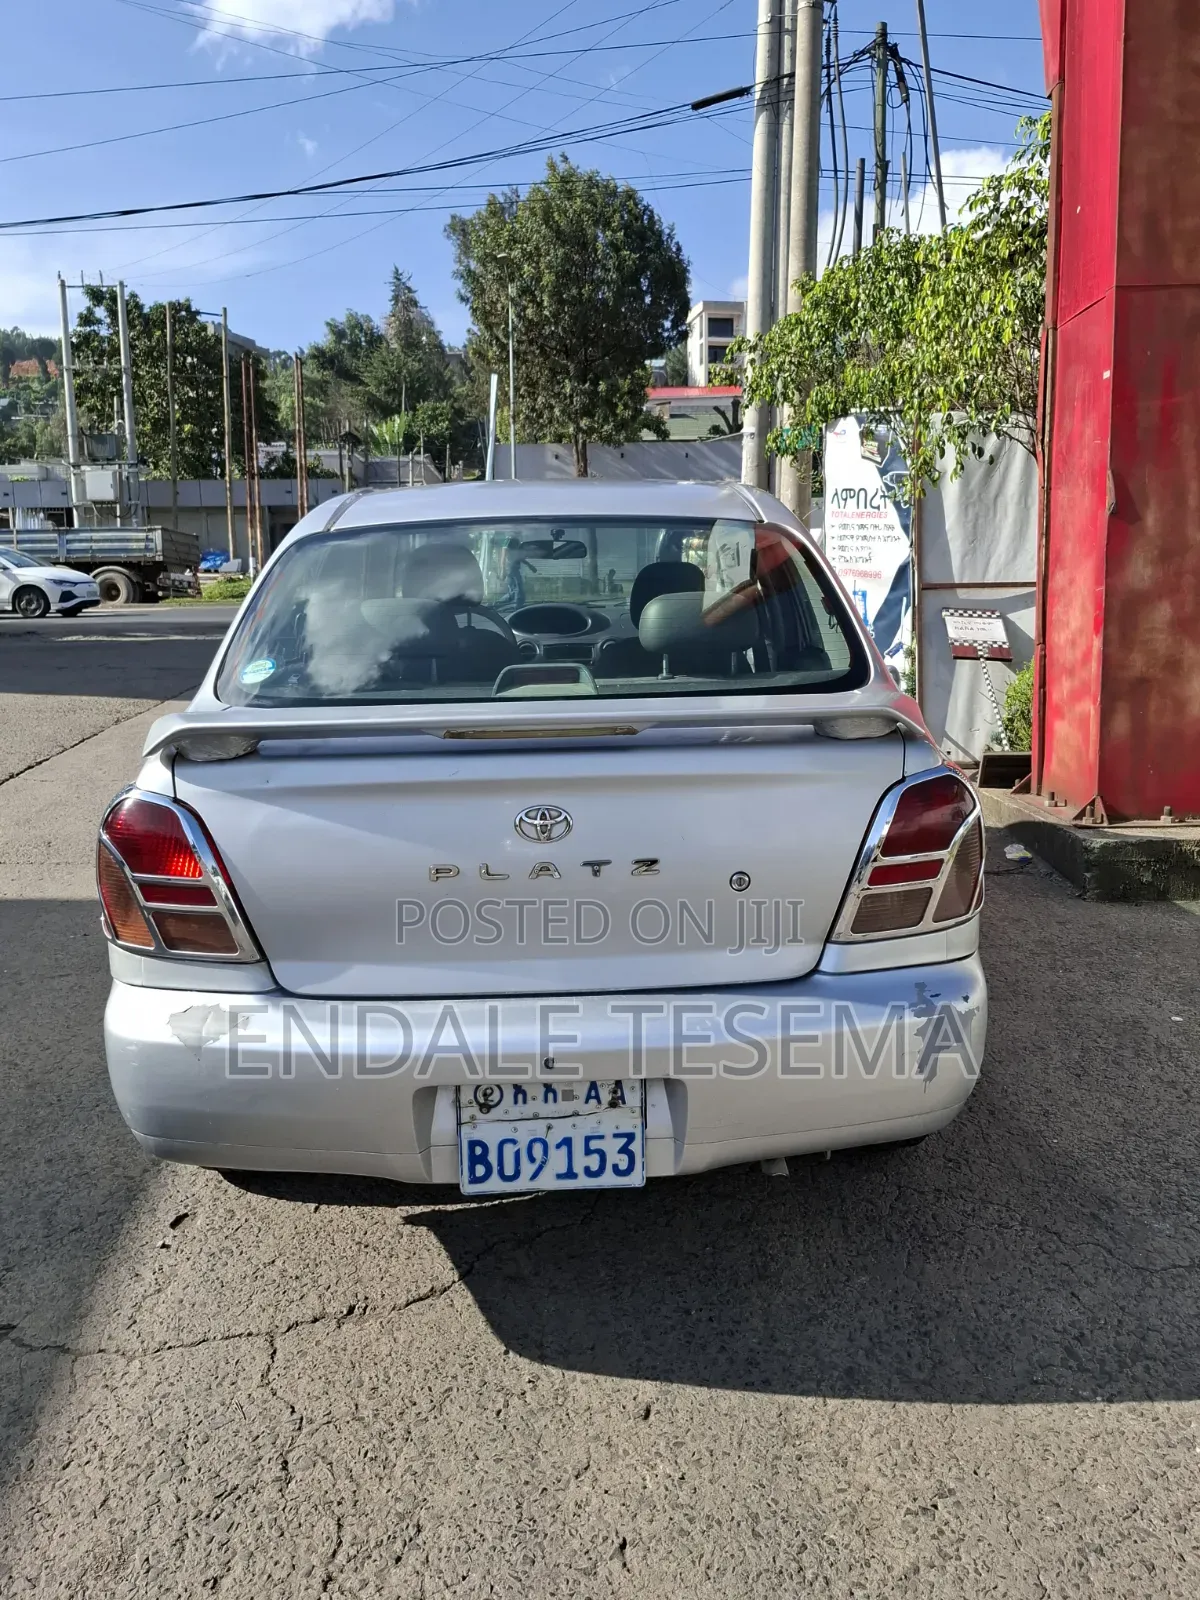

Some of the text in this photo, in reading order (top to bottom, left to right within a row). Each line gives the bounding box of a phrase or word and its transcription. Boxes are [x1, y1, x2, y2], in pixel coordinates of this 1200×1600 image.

[831, 511, 888, 519] TOTALENERGIES
[428, 857, 661, 882] PLATZ
[467, 1131, 637, 1185] B09153
